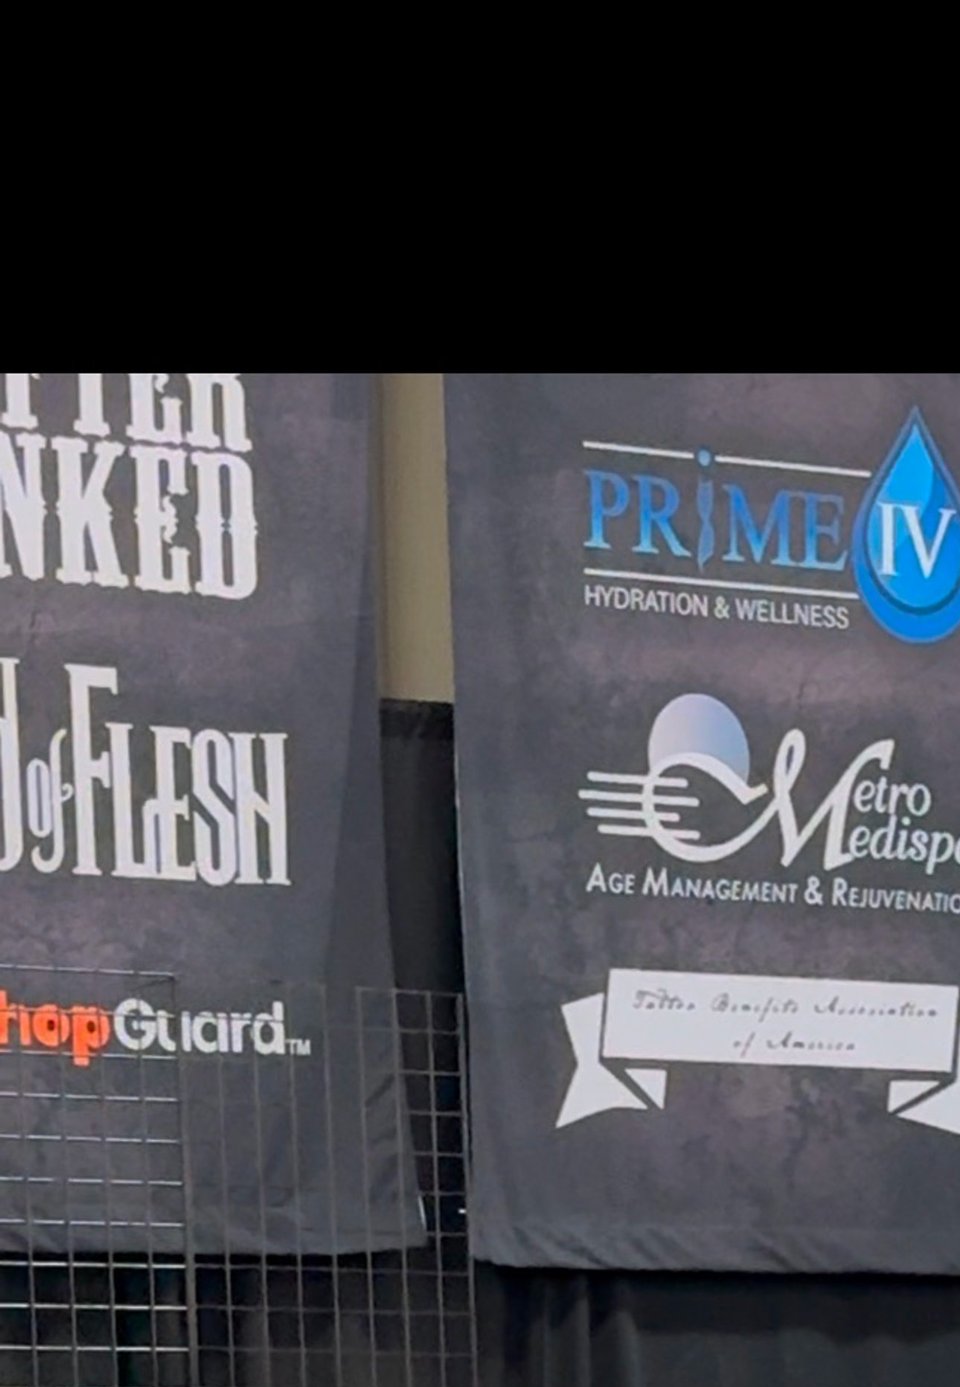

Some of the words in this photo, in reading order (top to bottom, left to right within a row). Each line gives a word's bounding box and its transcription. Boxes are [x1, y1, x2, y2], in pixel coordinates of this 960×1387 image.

[0, 430, 257, 599] NKED
[876, 502, 957, 579] IV
[584, 584, 708, 618] HYDRATION
[713, 597, 730, 620] &
[735, 599, 849, 630] WELLNESS
[64, 663, 291, 886] FLESH
[642, 866, 798, 904] MANAGEMENT
[804, 876, 823, 906] &
[711, 992, 800, 1023] Benefits
[813, 996, 938, 1018] Association
[732, 1032, 757, 1059] of
[766, 1031, 856, 1052] America
